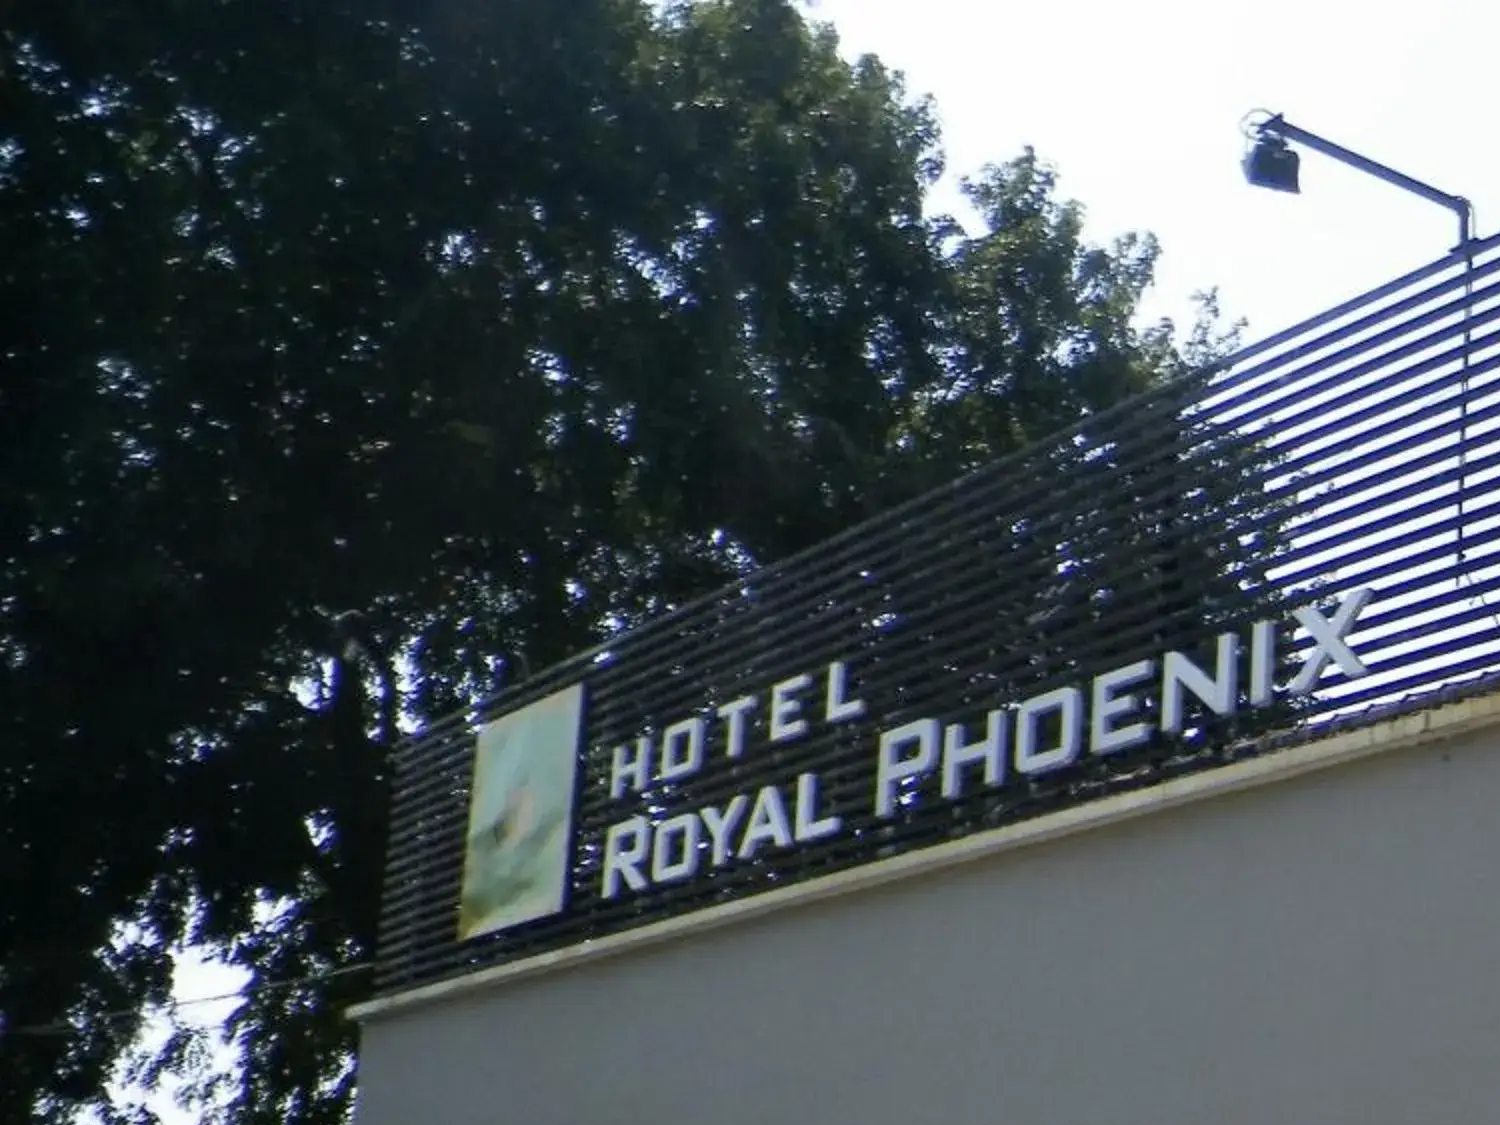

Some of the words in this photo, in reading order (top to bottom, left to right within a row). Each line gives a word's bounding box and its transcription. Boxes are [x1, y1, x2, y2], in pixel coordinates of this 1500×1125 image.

[602, 773, 844, 898] ROYAL
[875, 588, 1374, 818] PHOENIX
[610, 661, 867, 799] HOTEL
